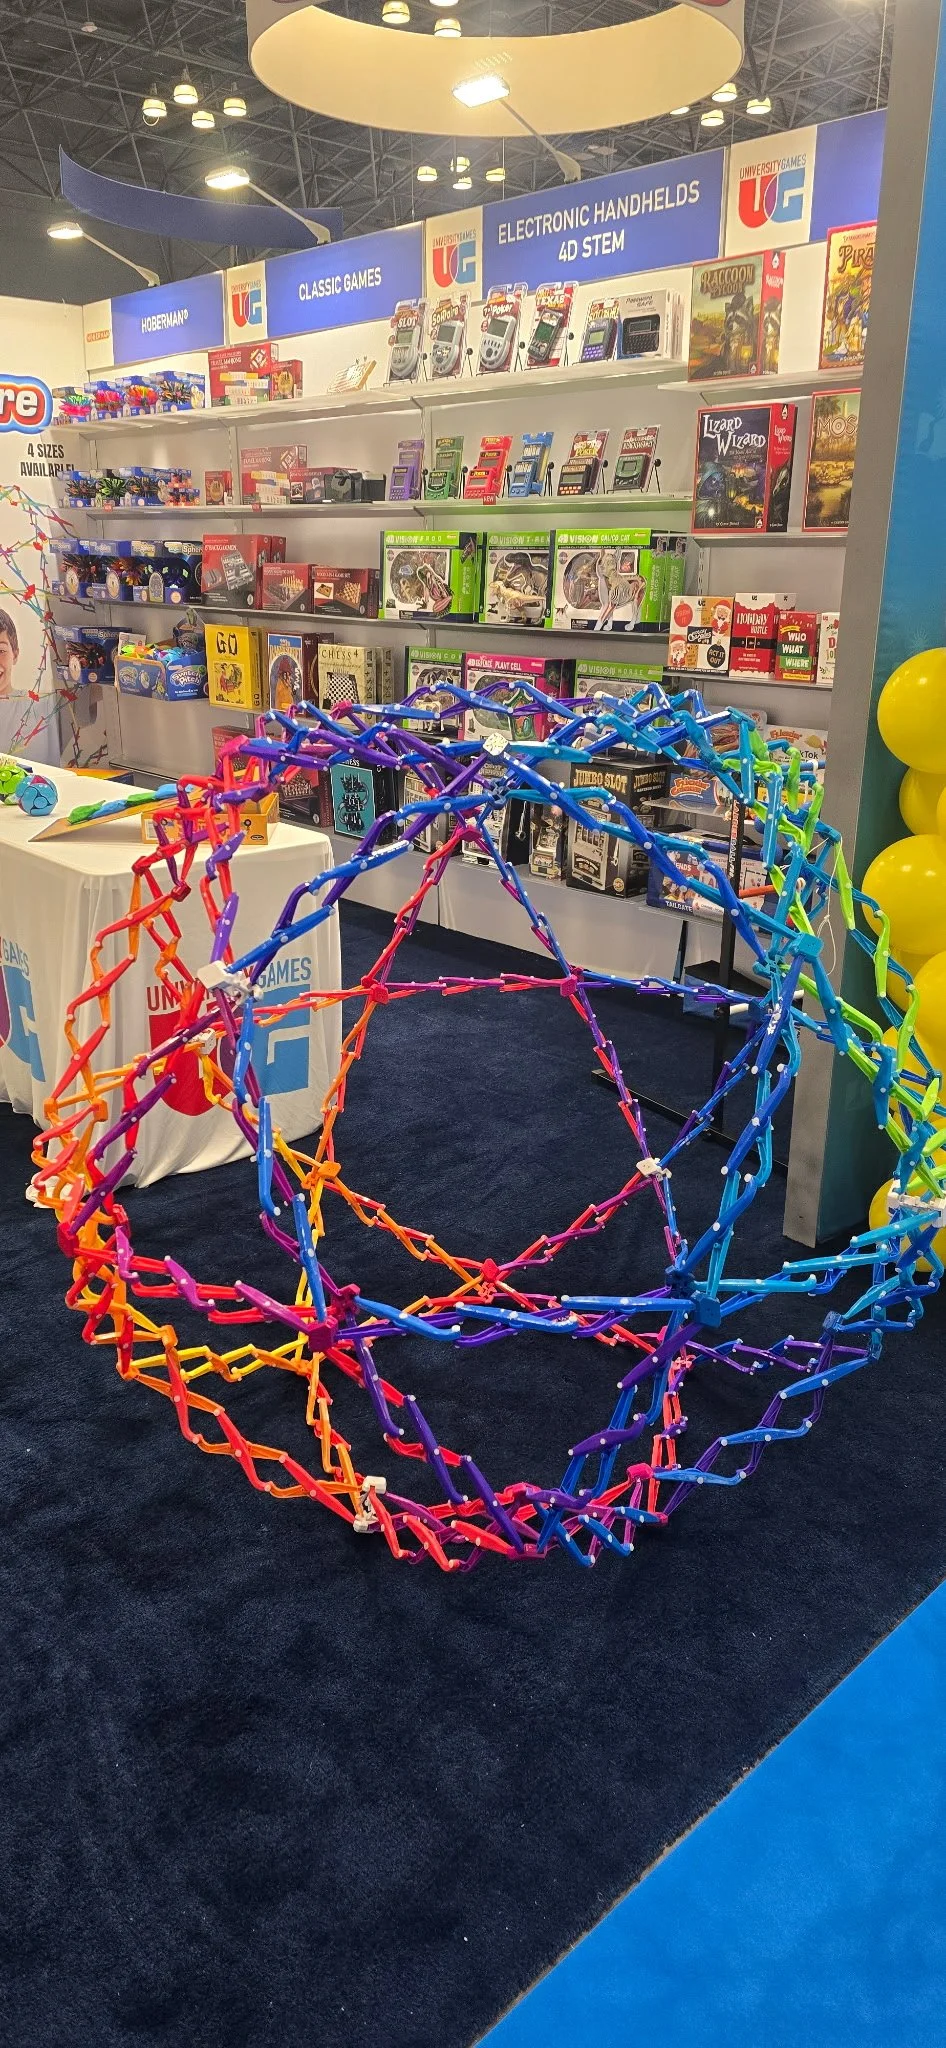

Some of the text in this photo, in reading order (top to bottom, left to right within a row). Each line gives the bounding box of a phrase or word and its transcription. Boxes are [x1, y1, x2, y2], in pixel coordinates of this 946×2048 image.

[498, 180, 700, 245] ELECTRONIC HANDHELDS
[558, 229, 625, 262] 4D STEM
[837, 243, 876, 273] PIRA
[701, 264, 755, 288] RACCOON
[299, 267, 382, 302] CLASSIC GAMES
[711, 284, 744, 296] TYCOON
[816, 414, 858, 438] MOS
[27, 442, 65, 458] 4 SIZES
[569, 534, 599, 544] VISION
[787, 631, 807, 642] WHO
[216, 631, 239, 657] GO
[782, 643, 804, 654] WHAT
[321, 649, 351, 660] CHESS
[420, 650, 441, 660] VISION
[494, 660, 510, 670] PLANT
[510, 662, 522, 671] CELL
[785, 657, 810, 668] WHERE
[588, 664, 616, 676] VISION
[799, 750, 819, 760] kTok
[573, 768, 603, 787] JUMBO
[604, 773, 628, 794] SLOT
[665, 900, 693, 913] TAILGATE
